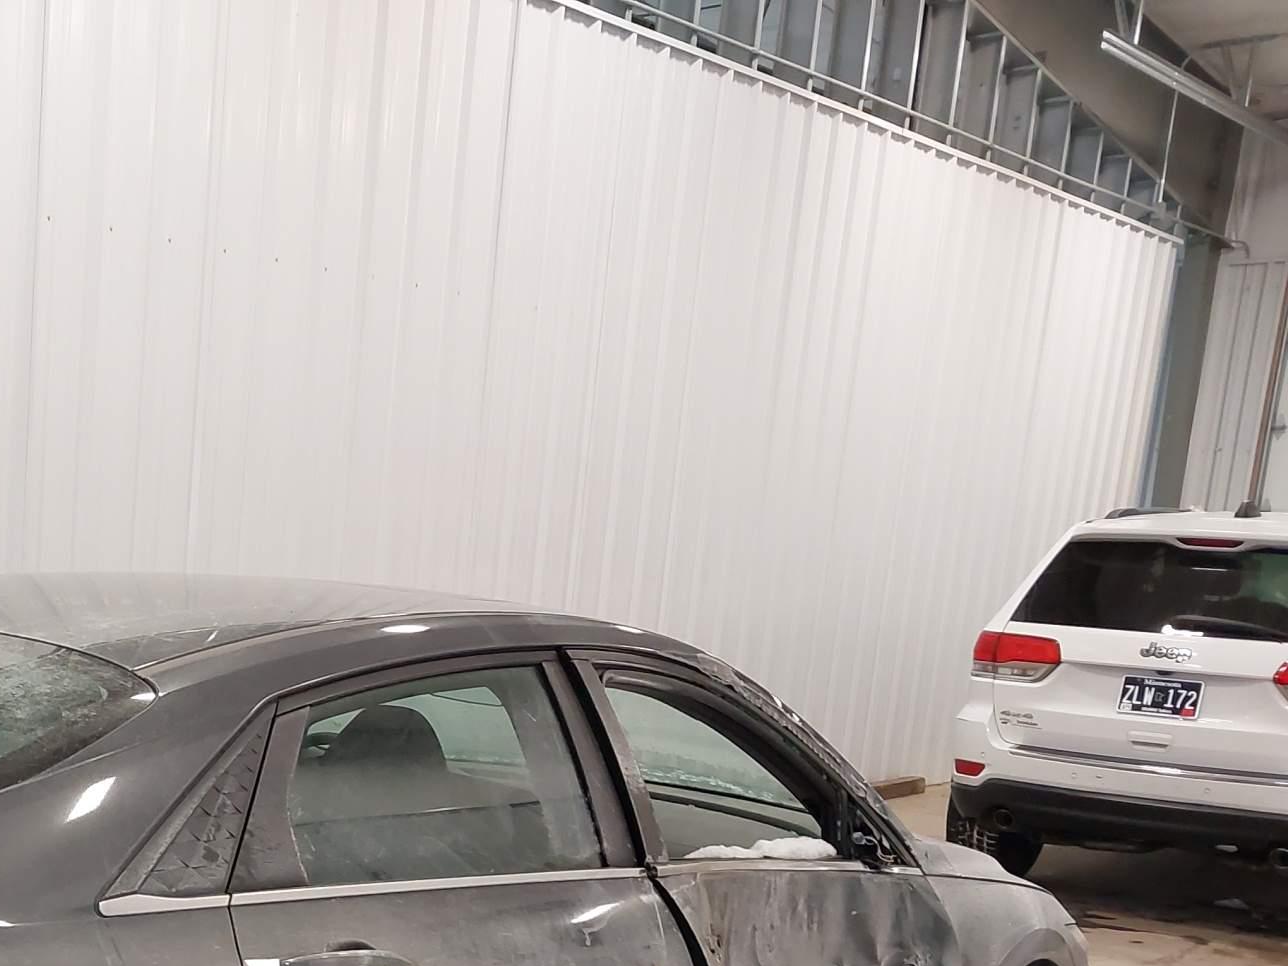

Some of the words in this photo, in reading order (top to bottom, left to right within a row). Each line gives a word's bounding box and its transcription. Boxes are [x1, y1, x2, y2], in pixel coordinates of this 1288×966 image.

[1139, 641, 1193, 663] Jeep
[1121, 684, 1156, 706] ZLW
[1163, 688, 1198, 710] 172
